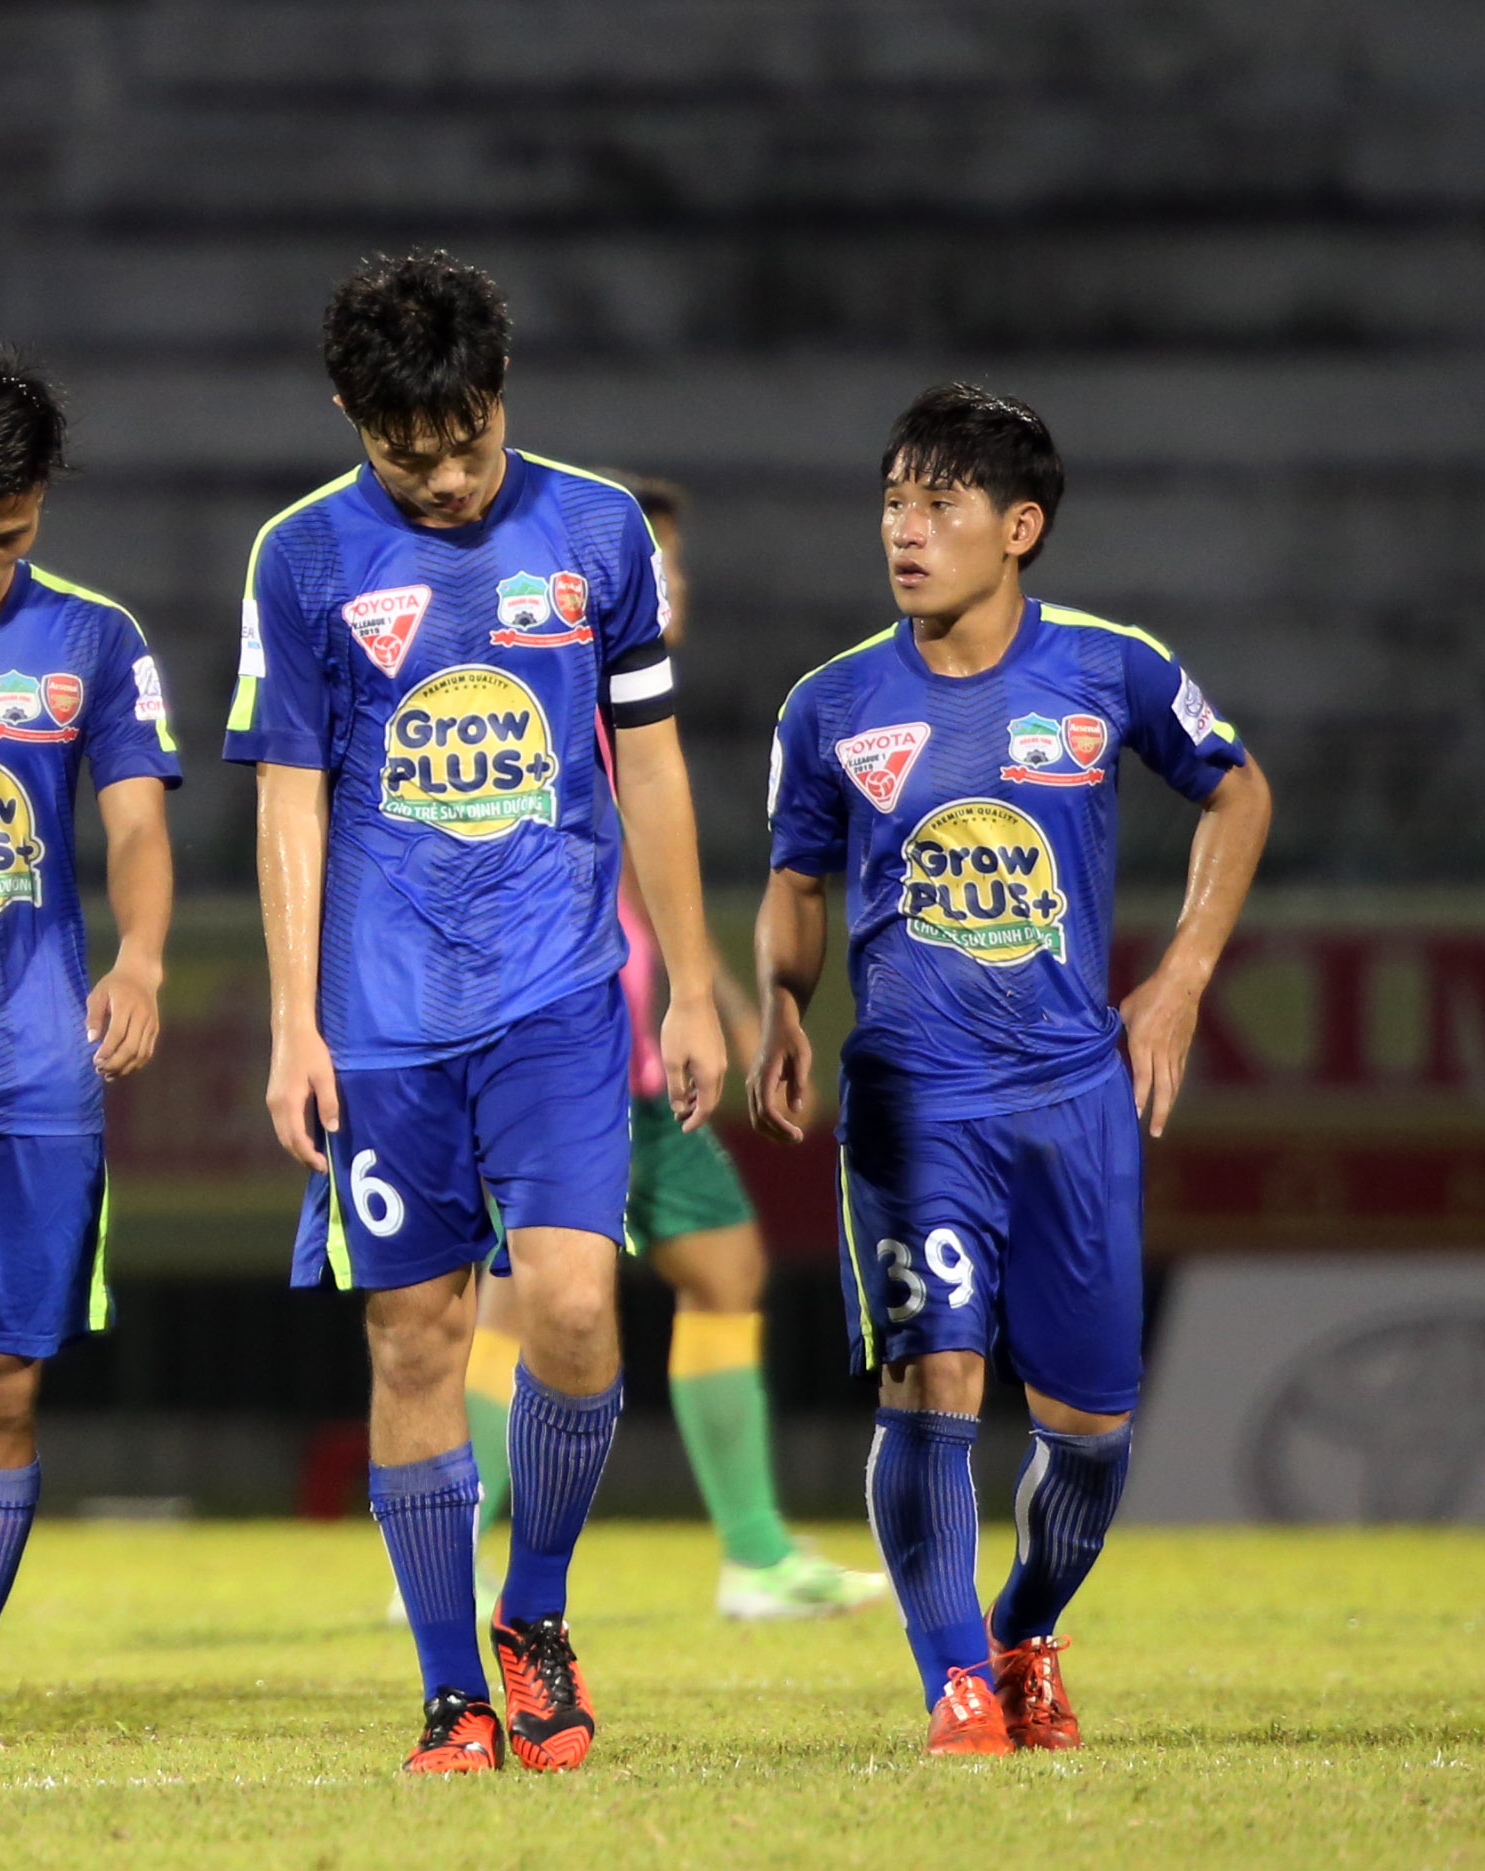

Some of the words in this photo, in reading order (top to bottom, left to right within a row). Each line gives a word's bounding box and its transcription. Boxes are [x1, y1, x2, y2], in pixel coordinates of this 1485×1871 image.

[423, 675, 465, 697] PREMIUM
[469, 675, 508, 689] QUALITY
[396, 709, 530, 749] Grow
[387, 749, 550, 794] PLUS+
[931, 807, 973, 830] PREMIUM
[977, 807, 1018, 824] QUALITY
[911, 841, 1039, 877] Grow
[909, 880, 1057, 919] PLUS+
[989, 929, 1021, 944] DINH
[350, 1149, 404, 1237] 6
[876, 1228, 974, 1322] 39
